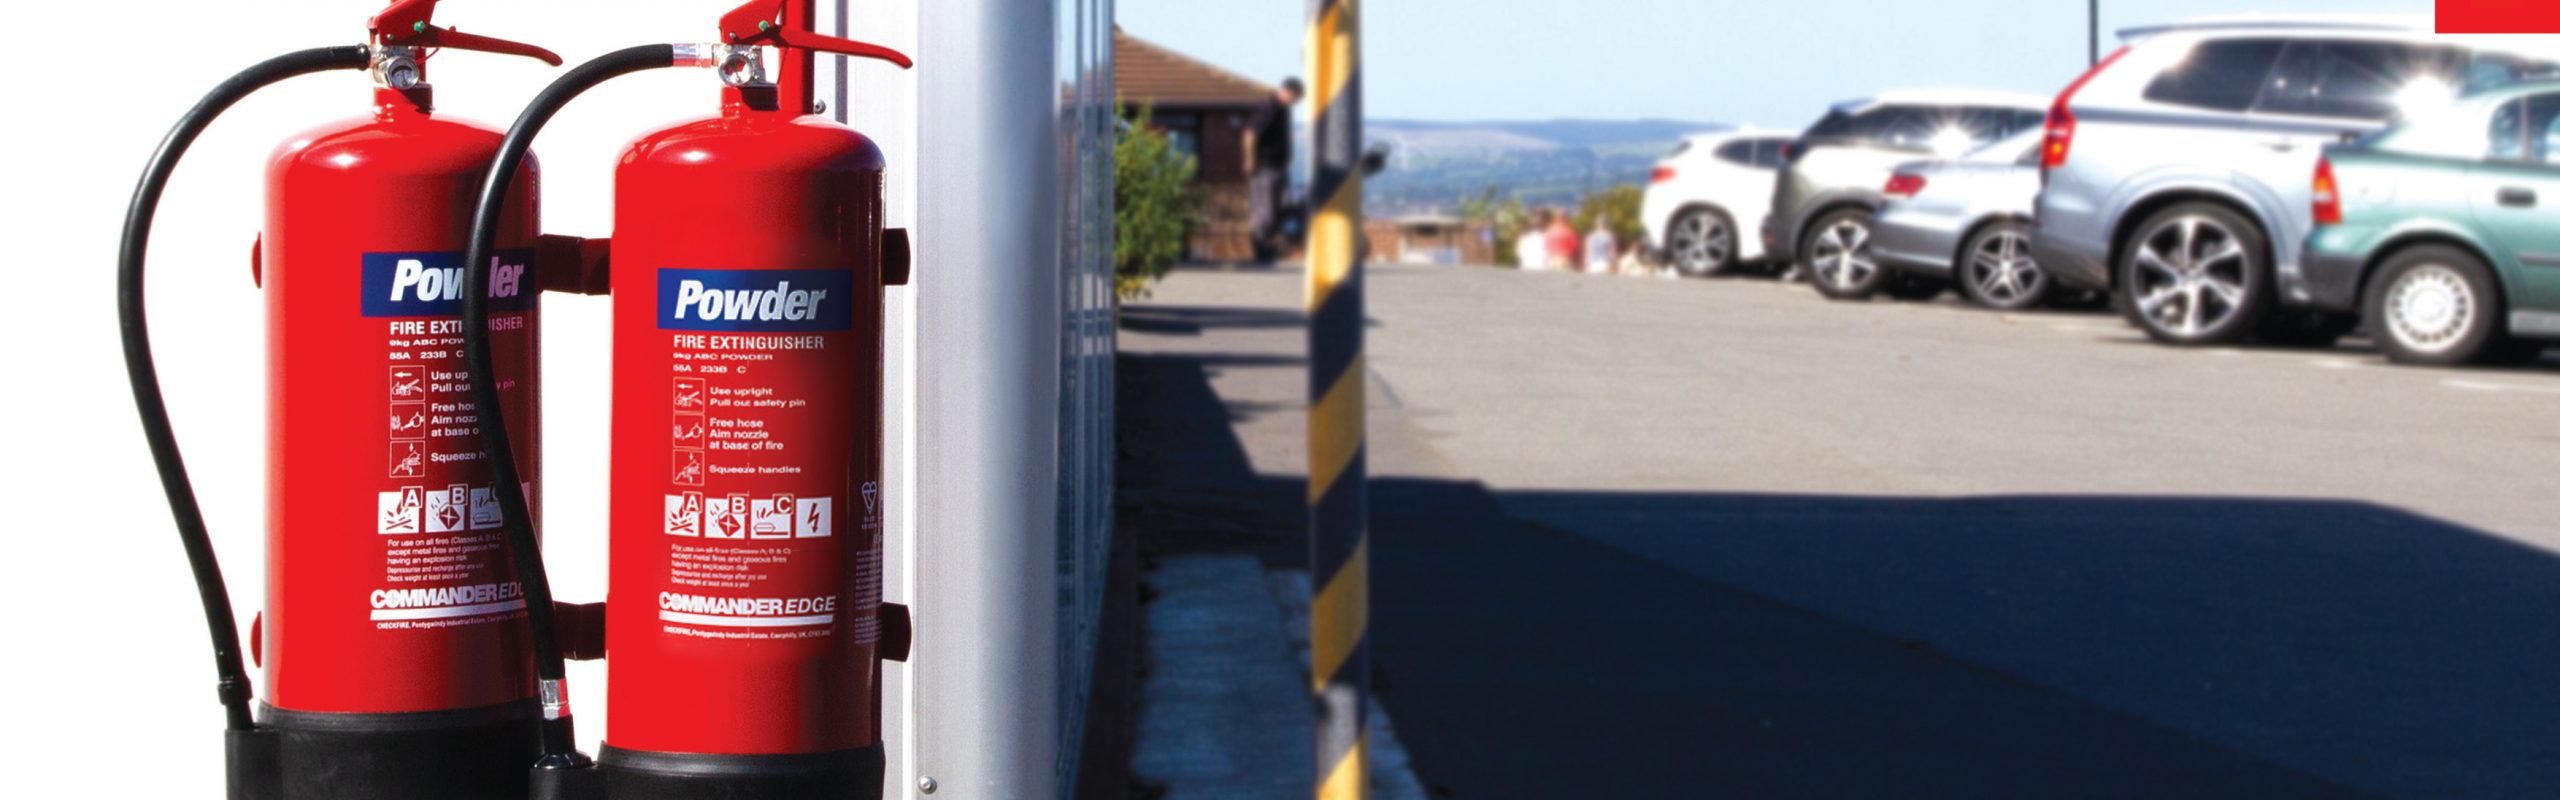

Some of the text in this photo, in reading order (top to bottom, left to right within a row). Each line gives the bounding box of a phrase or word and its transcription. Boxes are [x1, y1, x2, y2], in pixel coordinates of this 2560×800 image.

[674, 279, 827, 321] Powder
[390, 316, 523, 335] FIRE EXTIISHER
[389, 339, 410, 347] 9kg
[674, 335, 824, 349] FIRE EXTINGUISHER
[389, 350, 464, 360] 55A 233B C
[673, 352, 691, 360] 9kg
[700, 365, 728, 373] 233B
[431, 371, 453, 380] Use
[431, 384, 452, 392] Pull
[710, 387, 773, 397] Use upright
[431, 403, 456, 412] Free
[710, 398, 731, 406] Pull
[753, 399, 786, 408] safety
[789, 399, 806, 408] pin
[431, 415, 453, 424] Aim
[710, 418, 764, 427] Free hose
[431, 428, 442, 437] at
[445, 427, 470, 436] base
[710, 429, 769, 438] Aim nozzle
[709, 440, 784, 450] at base of fire
[431, 451, 477, 463] Squeeze
[709, 464, 801, 475] Squeeze handles
[405, 491, 420, 506] A
[452, 489, 466, 504] B
[685, 495, 699, 511] A
[732, 497, 745, 512] B
[776, 497, 791, 512] C
[387, 539, 399, 547] For
[435, 537, 449, 545] fires
[387, 549, 411, 557] except
[672, 552, 692, 560] except
[387, 558, 410, 566] having
[423, 556, 455, 564] explosion
[672, 560, 692, 569] having
[702, 563, 734, 571] explosion
[433, 565, 453, 573] recharge
[387, 574, 403, 582] Check
[405, 573, 421, 582] weight
[429, 572, 440, 580] least
[370, 584, 498, 608] COMMANDER
[659, 591, 836, 615] COMMANDER EDGE
